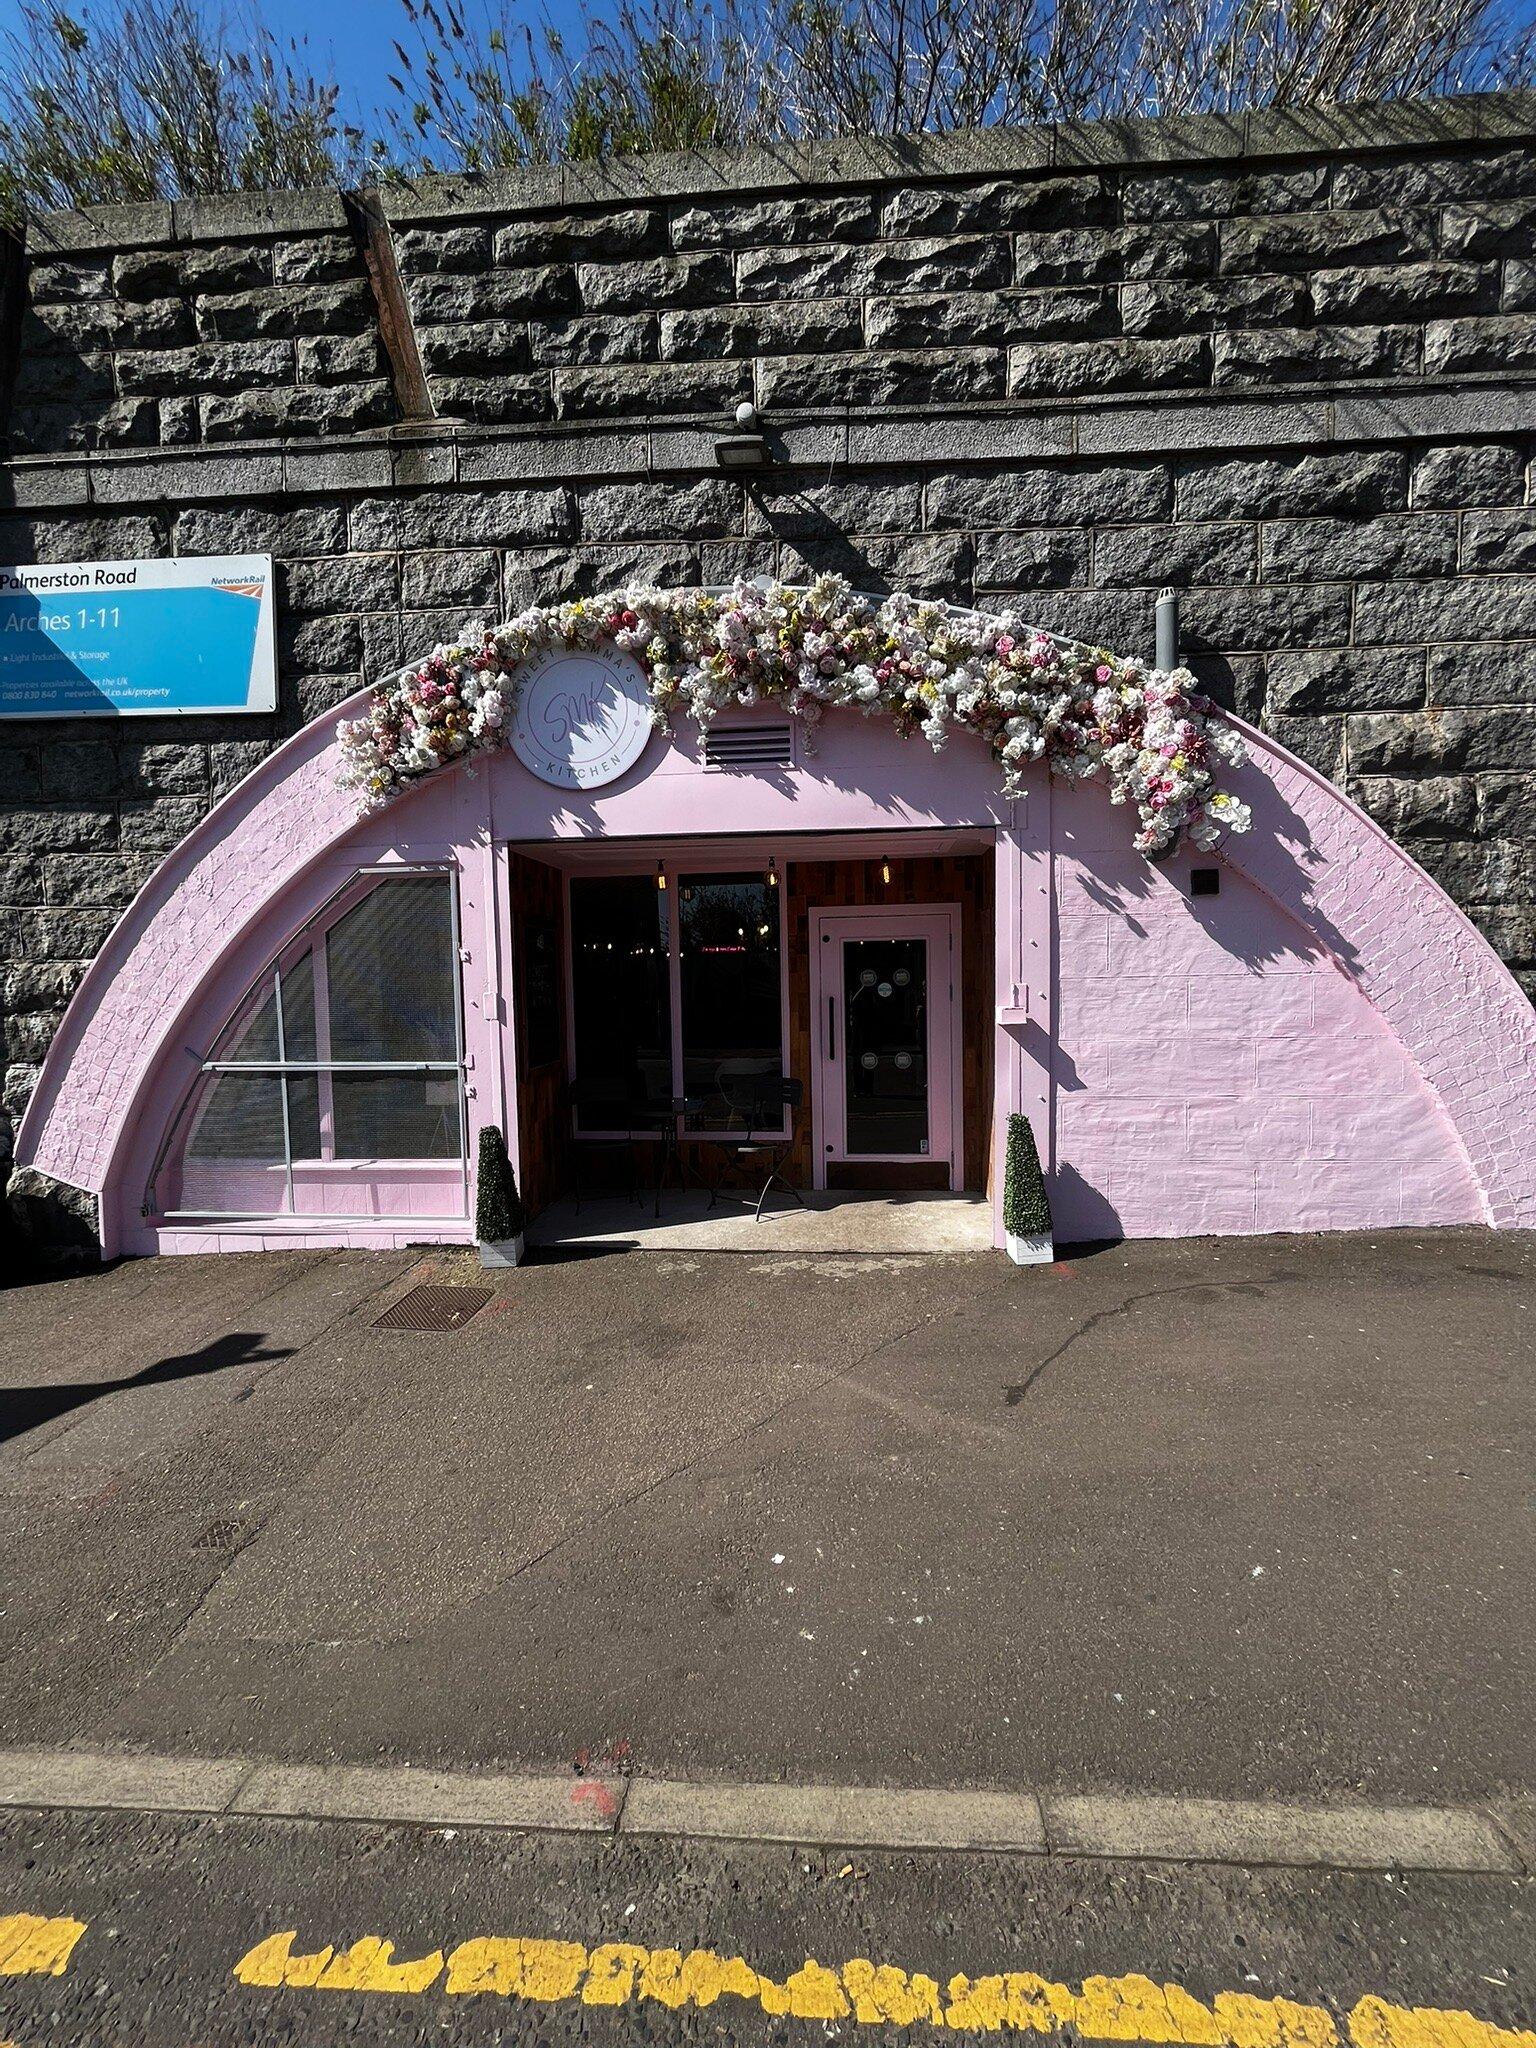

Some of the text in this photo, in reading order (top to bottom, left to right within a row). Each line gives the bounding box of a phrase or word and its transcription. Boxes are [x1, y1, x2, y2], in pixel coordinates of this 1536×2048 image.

[0, 567, 137, 590] Palmerston Road
[4, 607, 120, 632] Arches 1-11
[32, 652, 69, 661] Industri
[79, 650, 110, 662] Storage
[102, 678, 115, 686] the
[117, 677, 128, 686] UK
[515, 648, 556, 695] SWEET
[543, 673, 619, 744] SMK
[546, 754, 622, 779] KITCHEN
